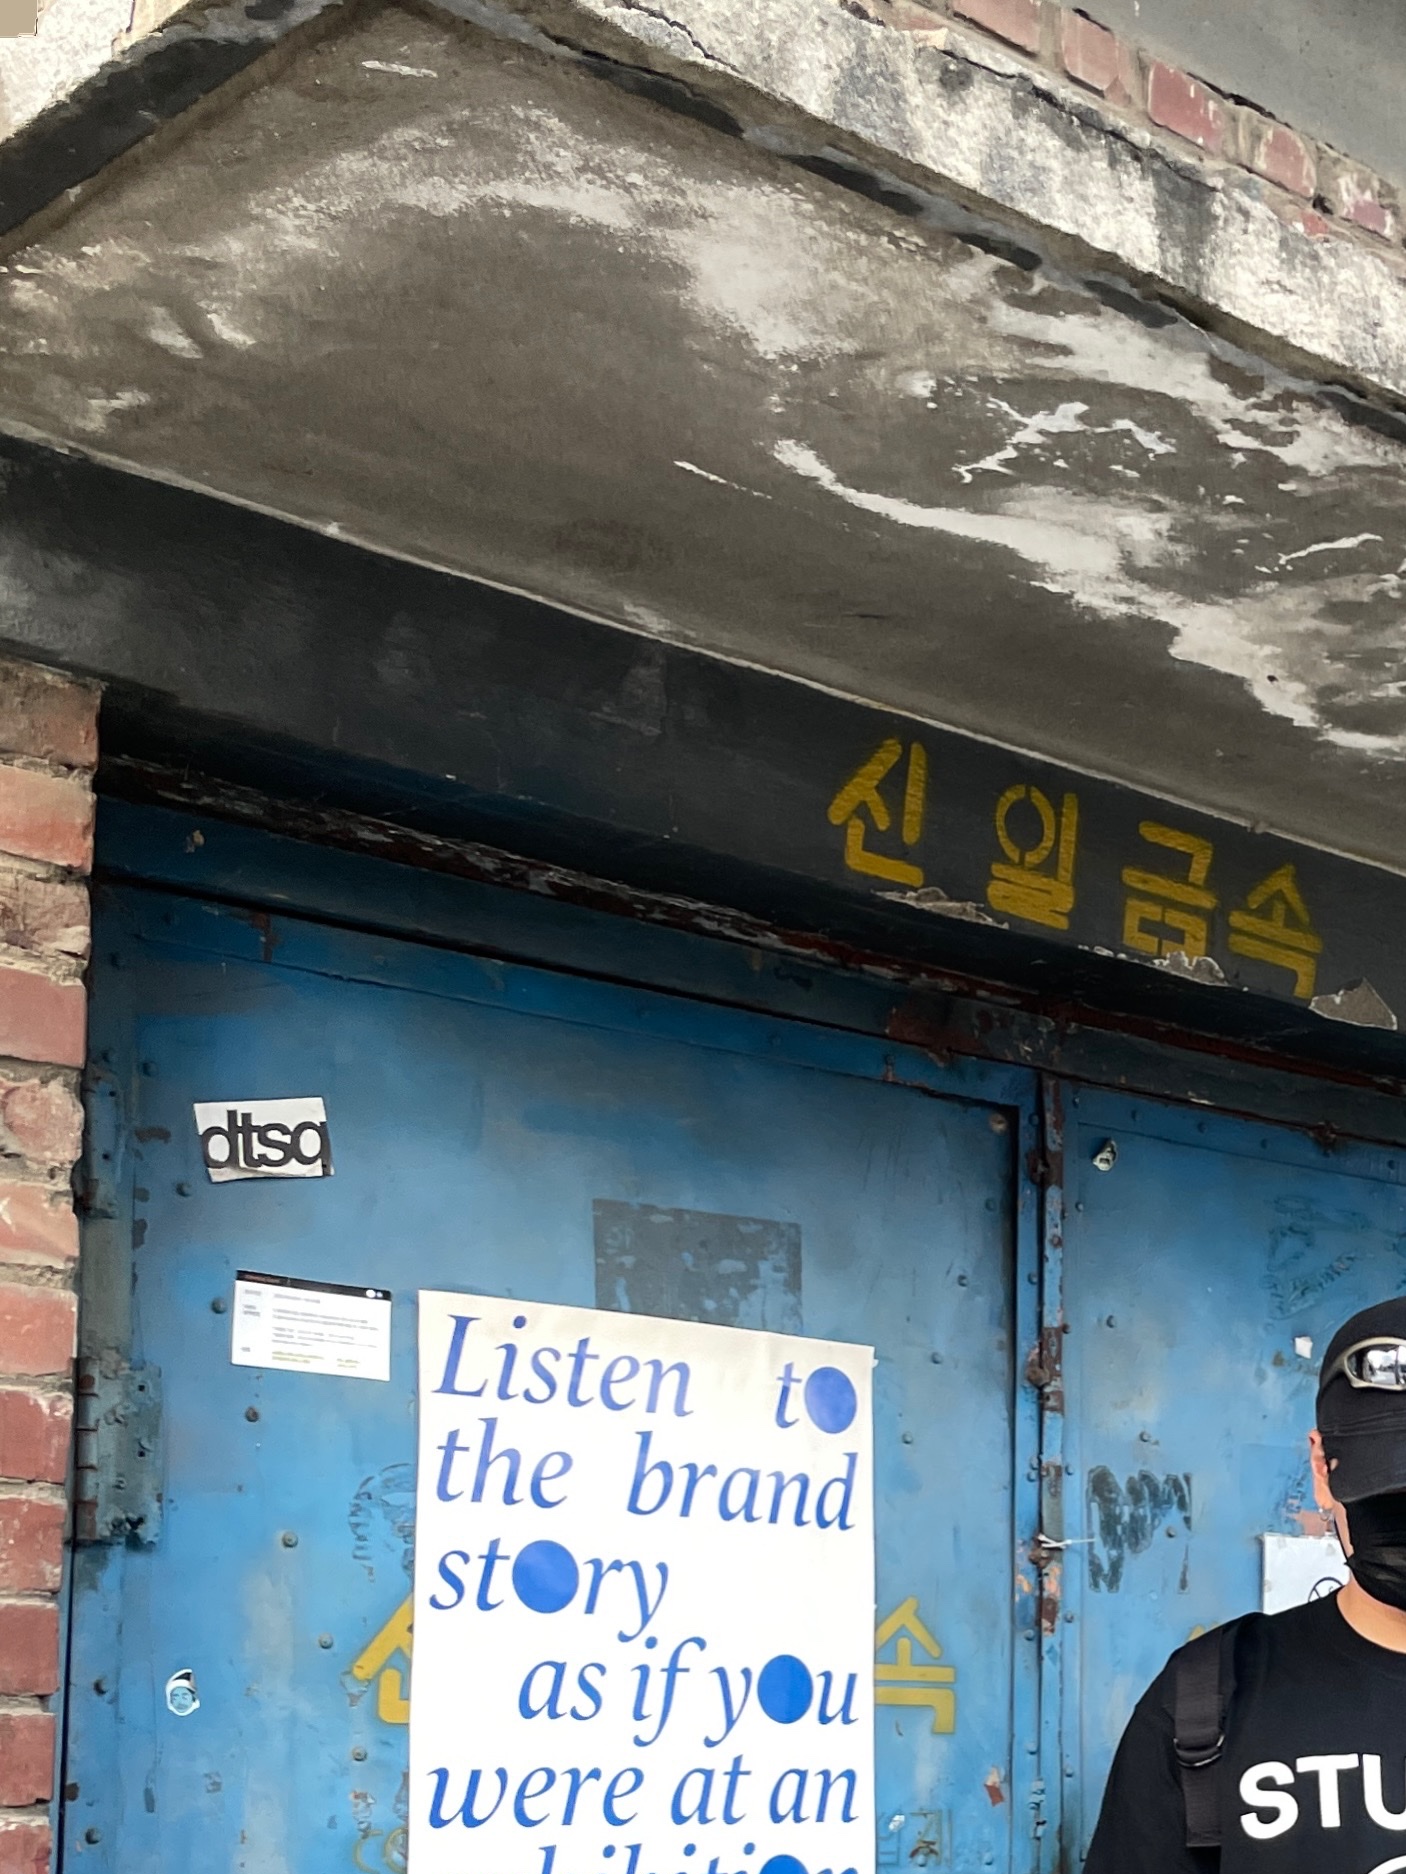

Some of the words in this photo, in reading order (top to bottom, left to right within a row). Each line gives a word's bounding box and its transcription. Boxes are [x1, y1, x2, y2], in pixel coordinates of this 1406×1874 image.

[827, 737, 1323, 1000] 신일금속
[431, 1314, 694, 1417] Listen
[435, 1417, 574, 1509] the
[626, 1430, 859, 1531] brand
[429, 1537, 670, 1642] story
[518, 1660, 607, 1721] as
[630, 1636, 707, 1747] if
[426, 1766, 645, 1829] were
[670, 1754, 753, 1825] at
[768, 1767, 859, 1824] an
